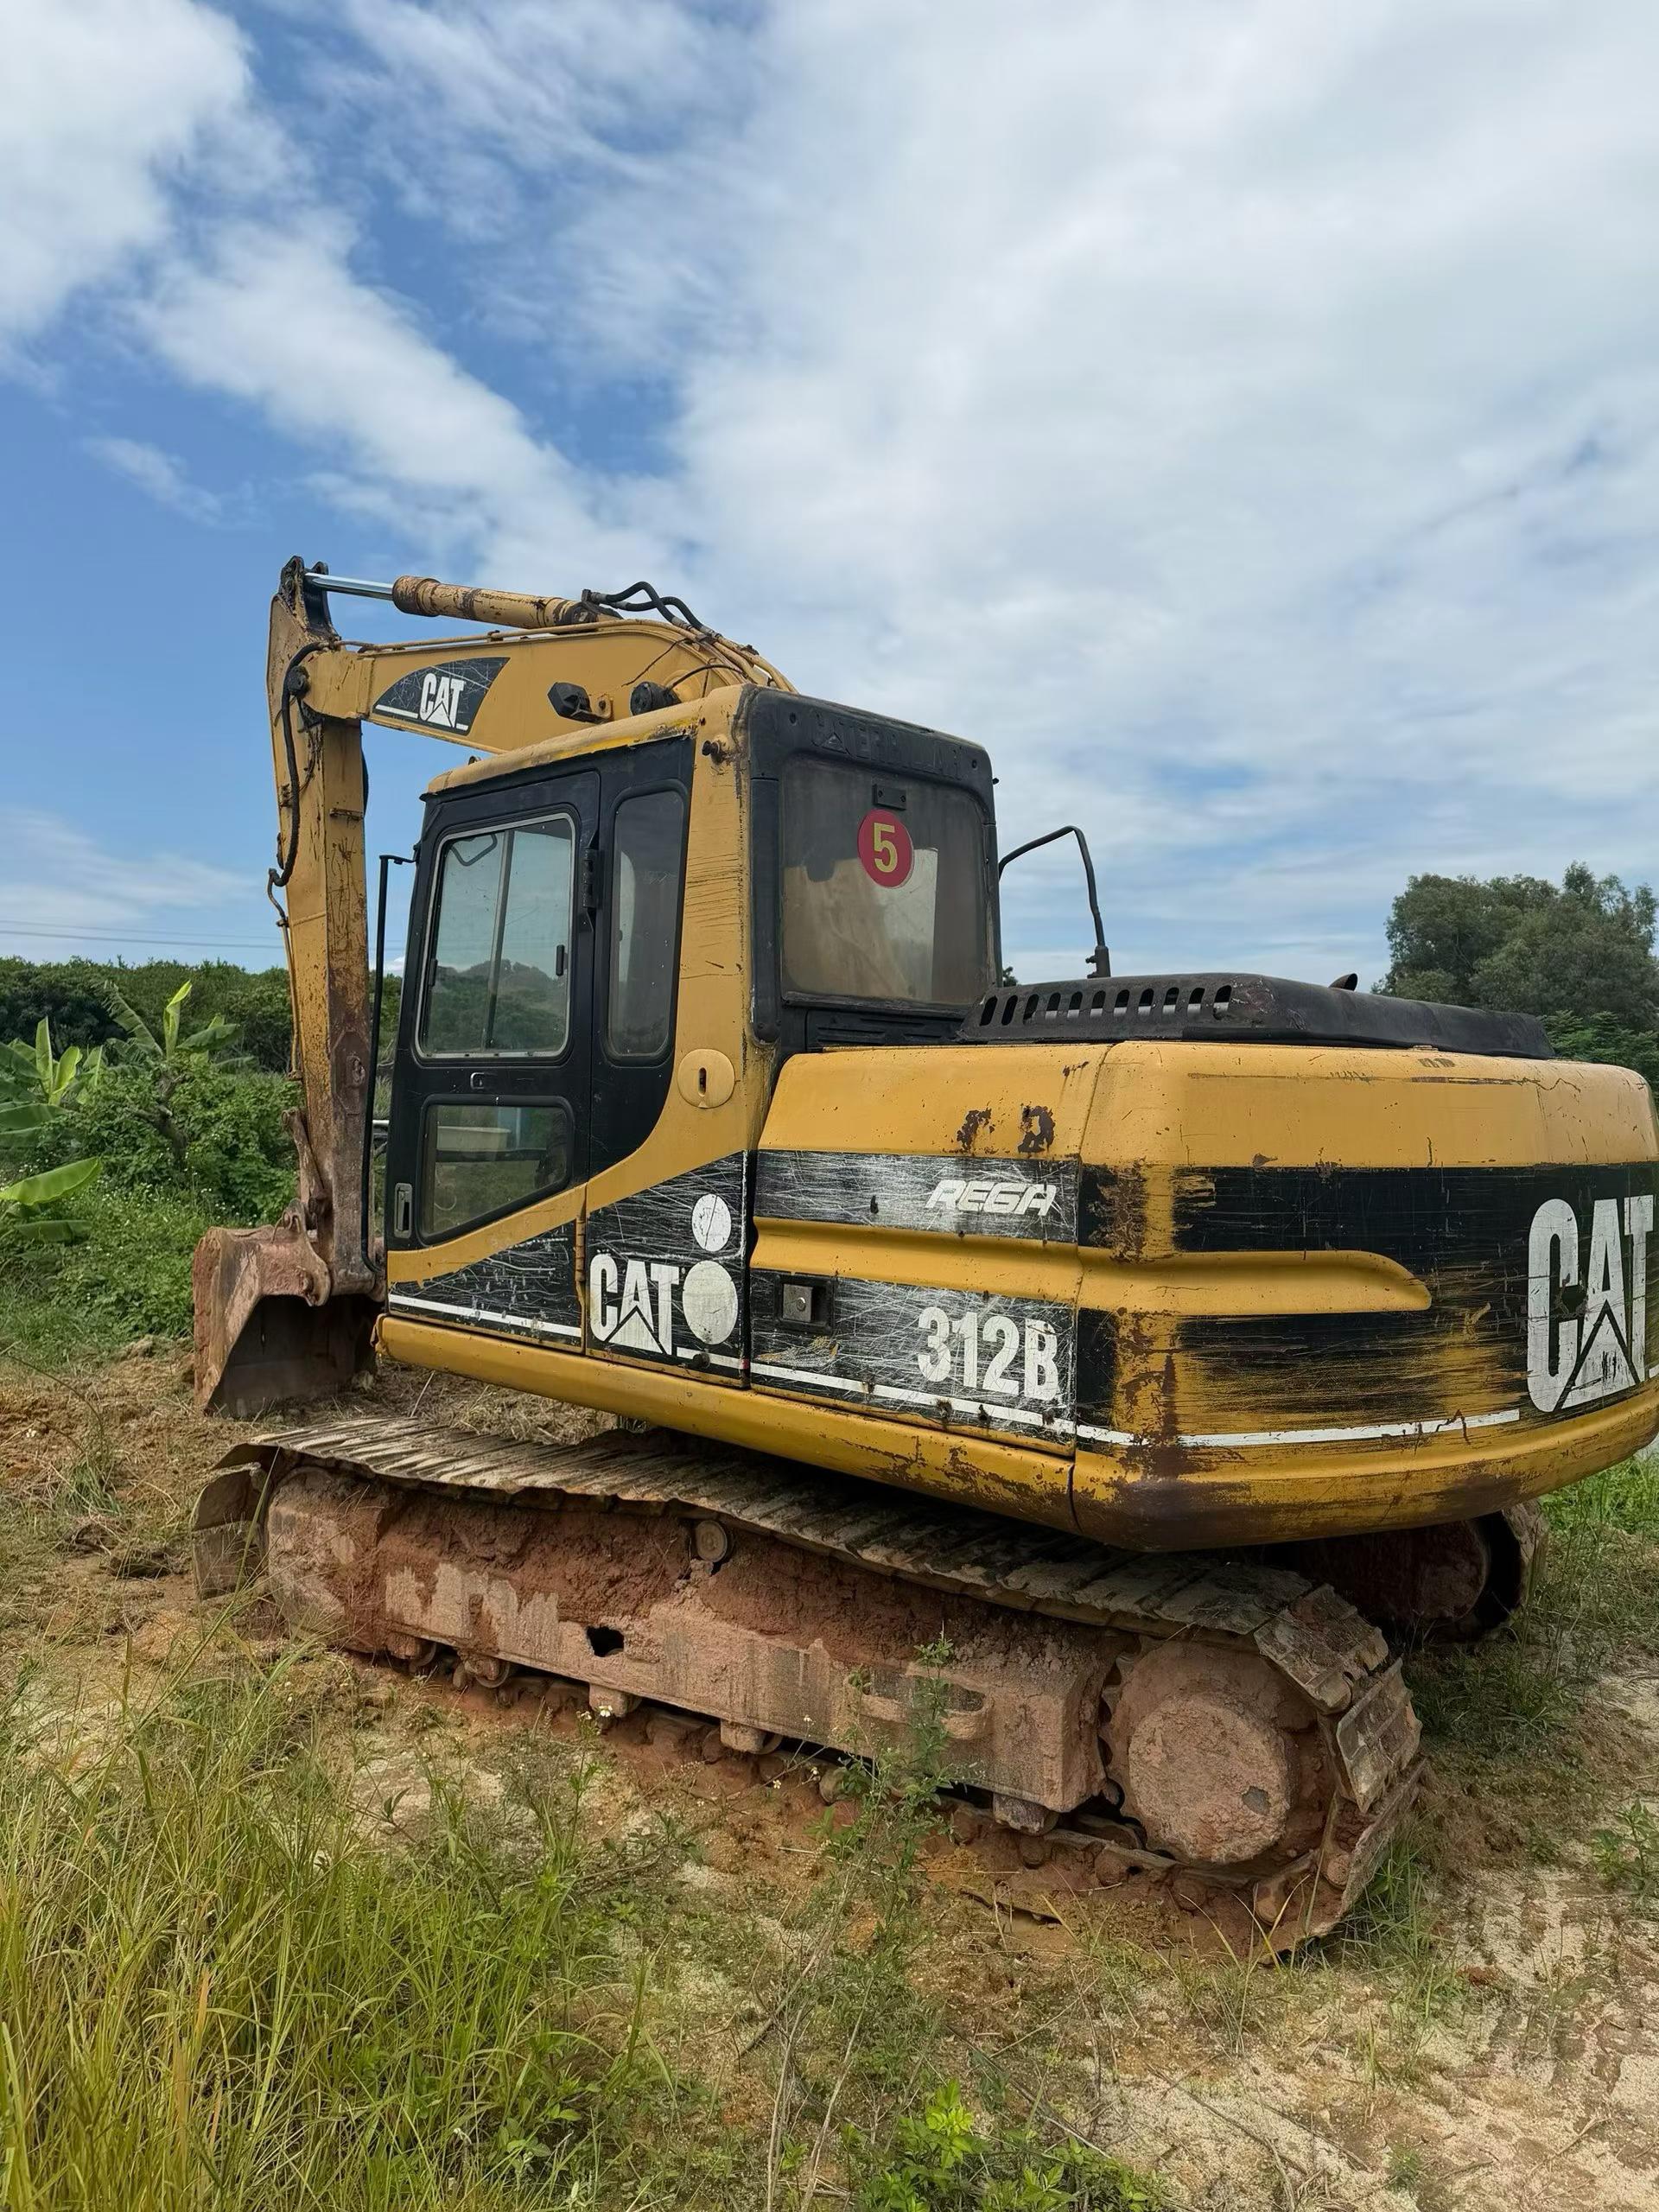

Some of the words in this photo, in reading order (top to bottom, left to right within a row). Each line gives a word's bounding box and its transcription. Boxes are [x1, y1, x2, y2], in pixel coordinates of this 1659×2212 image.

[419, 672, 467, 728] CAT
[874, 822, 898, 873] 5
[925, 1179, 1057, 1216] REGA
[589, 1254, 680, 1356] CAT
[1527, 1194, 1654, 1413] CAT
[918, 1306, 1059, 1401] 312B
